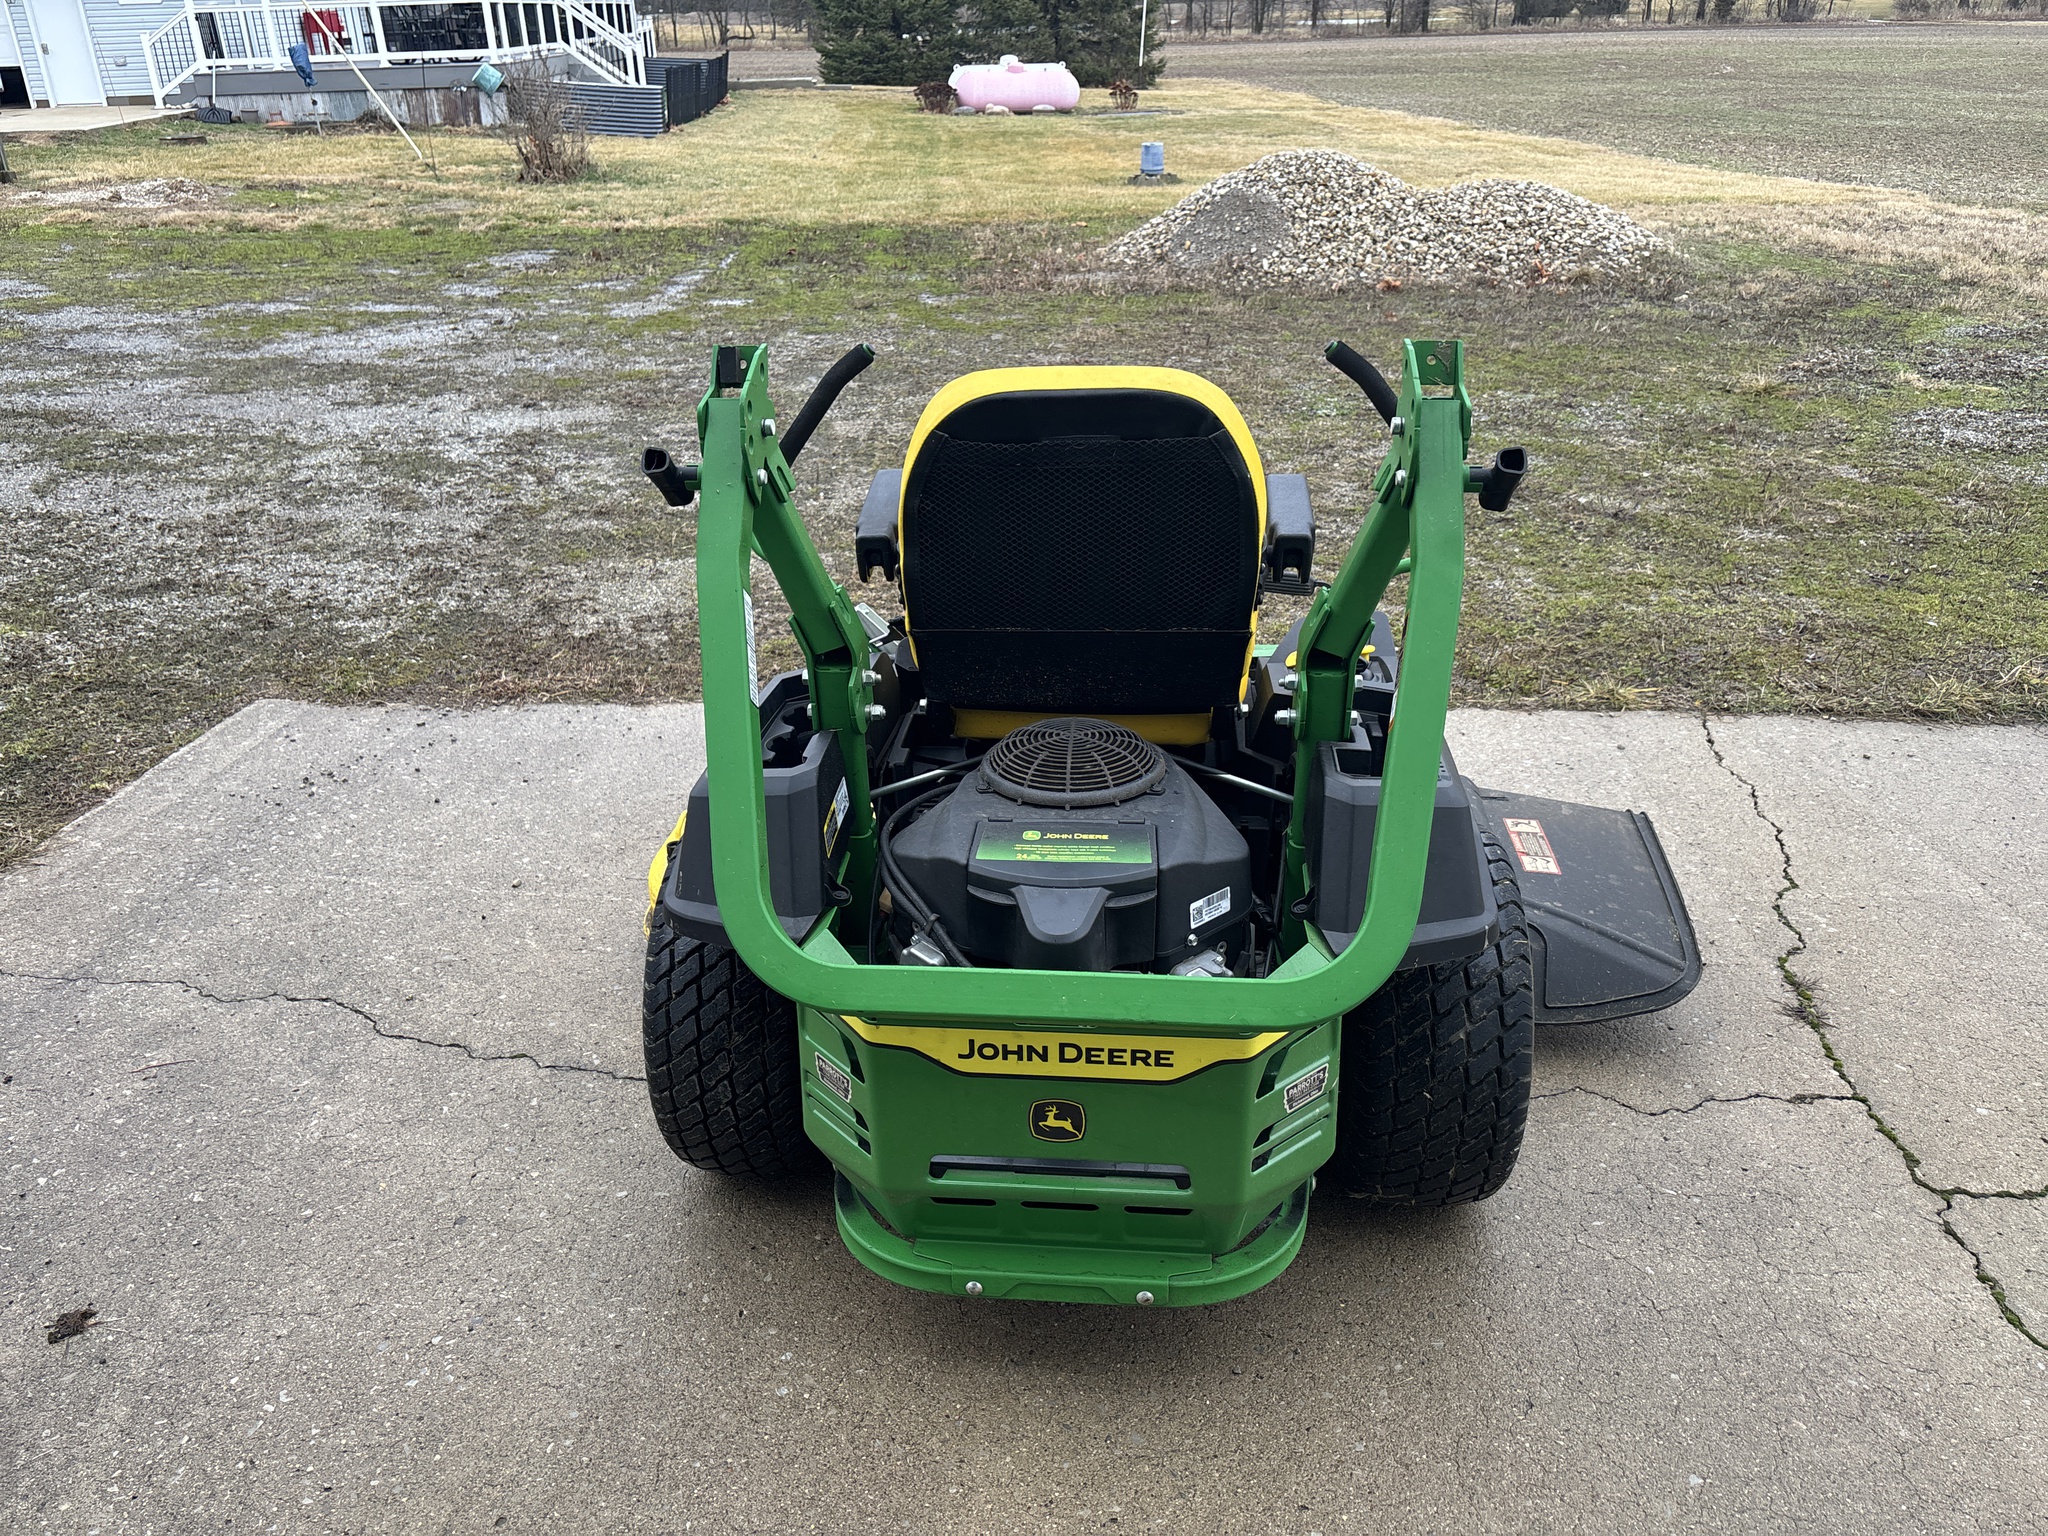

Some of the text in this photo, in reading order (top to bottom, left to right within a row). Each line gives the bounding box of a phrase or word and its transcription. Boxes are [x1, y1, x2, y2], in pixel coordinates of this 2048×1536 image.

[958, 1038, 1175, 1068] JOHN DEERE
[1288, 1071, 1324, 1098] PARROTT'S
